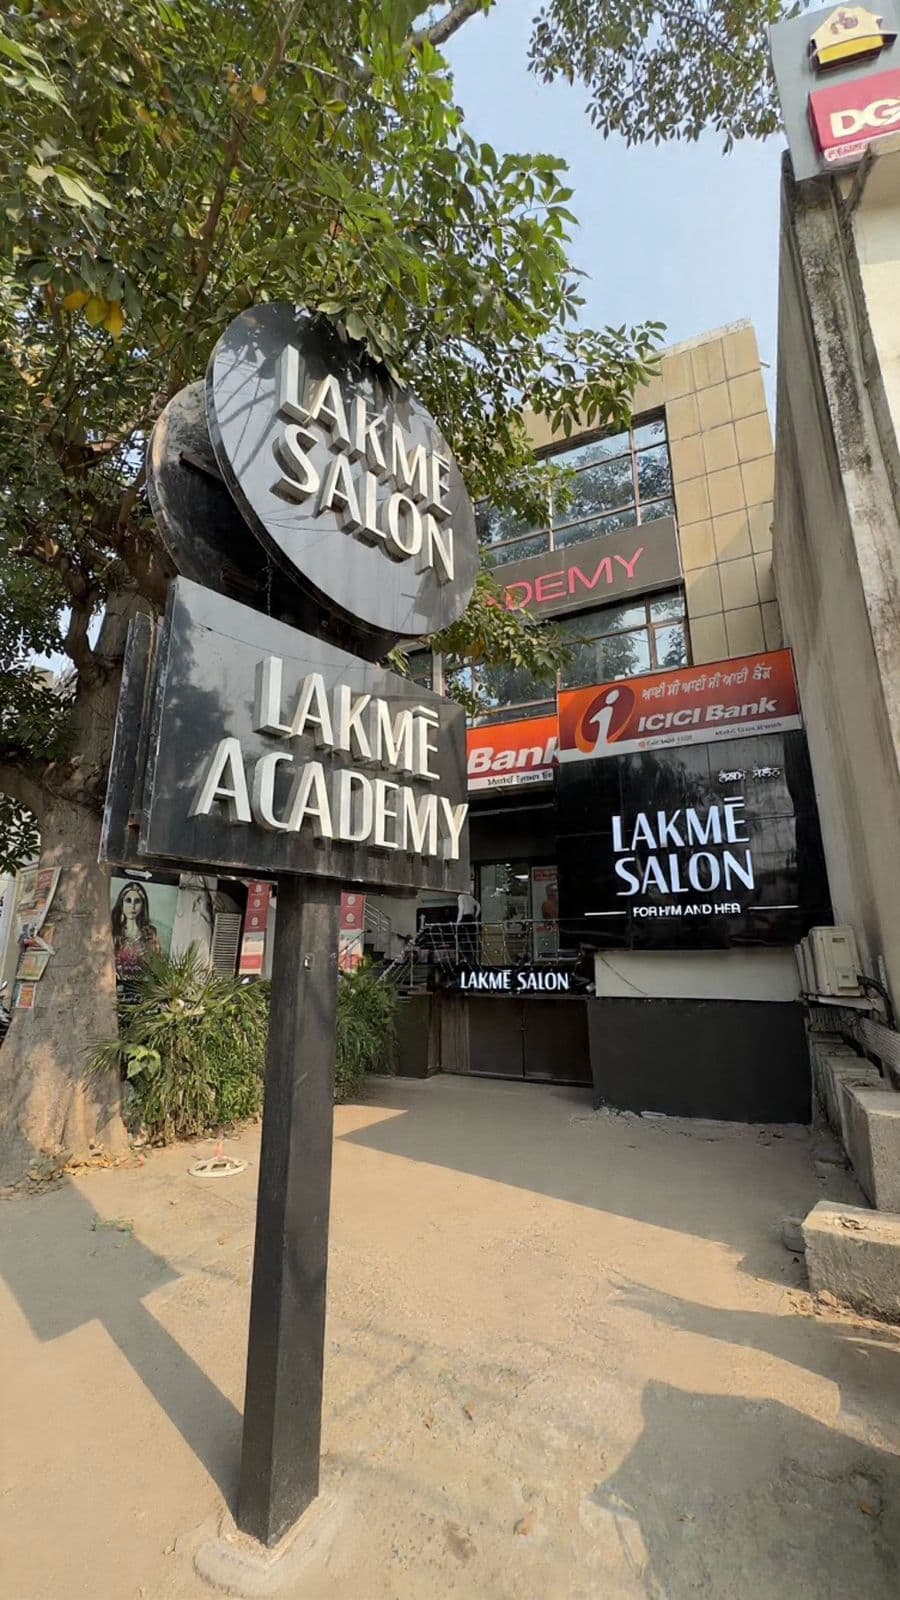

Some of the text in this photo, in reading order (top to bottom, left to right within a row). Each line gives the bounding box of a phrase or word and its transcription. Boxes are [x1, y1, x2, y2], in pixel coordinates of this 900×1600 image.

[270, 424, 454, 584] SALON
[487, 547, 645, 610] DEMY
[637, 697, 778, 732] ICICI Bank
[467, 736, 559, 774] Bank
[194, 736, 469, 861] ACADEMY
[614, 849, 755, 896] SALON
[633, 902, 741, 917] FOR HIM AND HER
[516, 971, 570, 991] SALON
